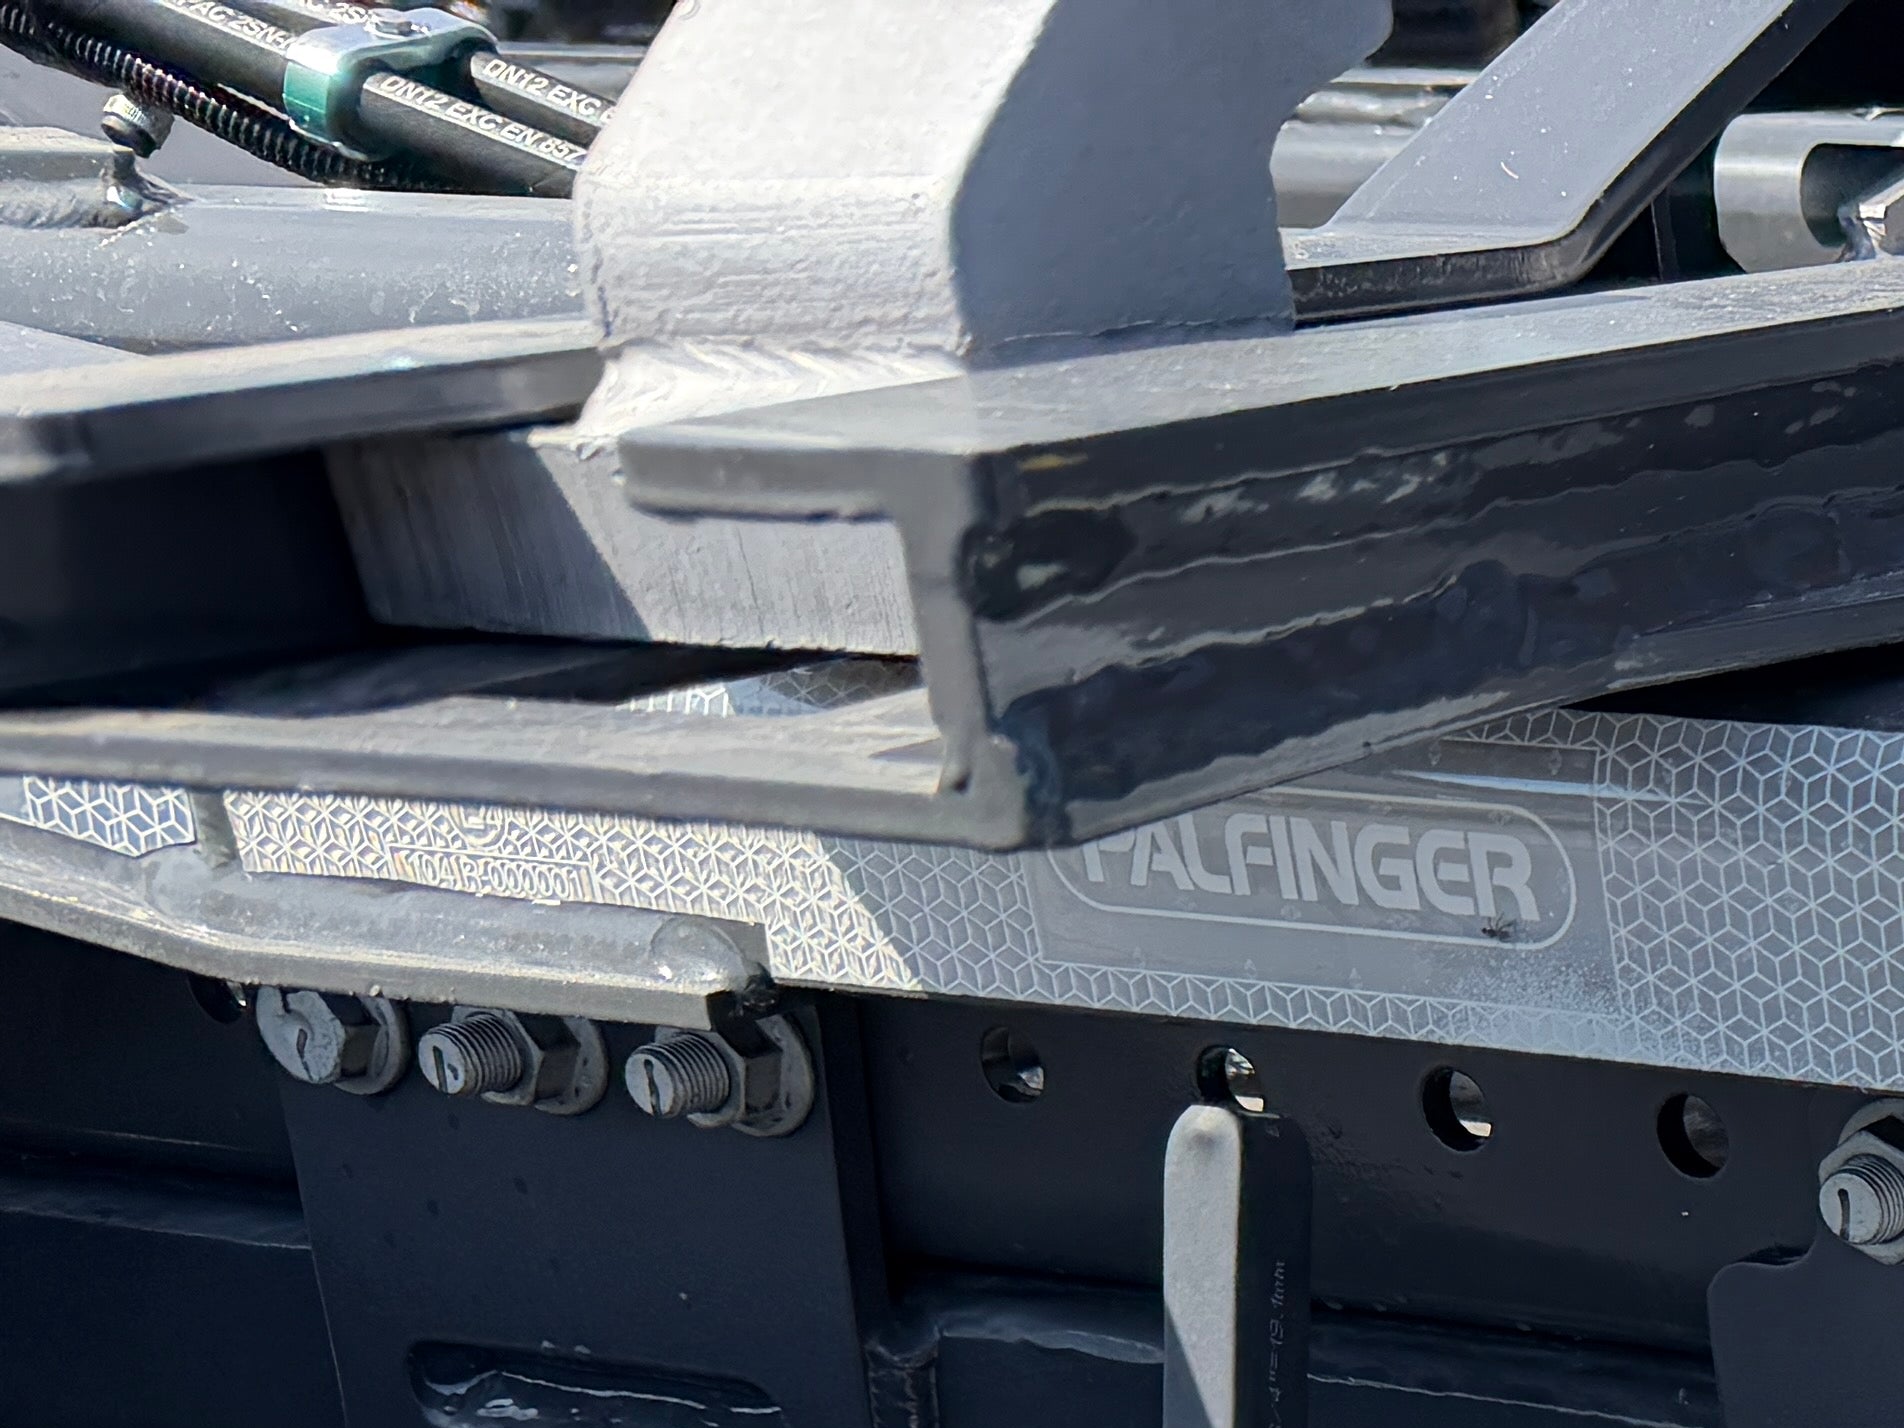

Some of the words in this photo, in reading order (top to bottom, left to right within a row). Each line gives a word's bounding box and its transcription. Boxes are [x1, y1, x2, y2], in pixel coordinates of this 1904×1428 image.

[380, 75, 450, 110] DN12
[445, 102, 504, 131] EXC
[483, 58, 549, 96] DN12
[546, 84, 602, 116] EXC
[1081, 812, 1540, 922] PALFINGER
